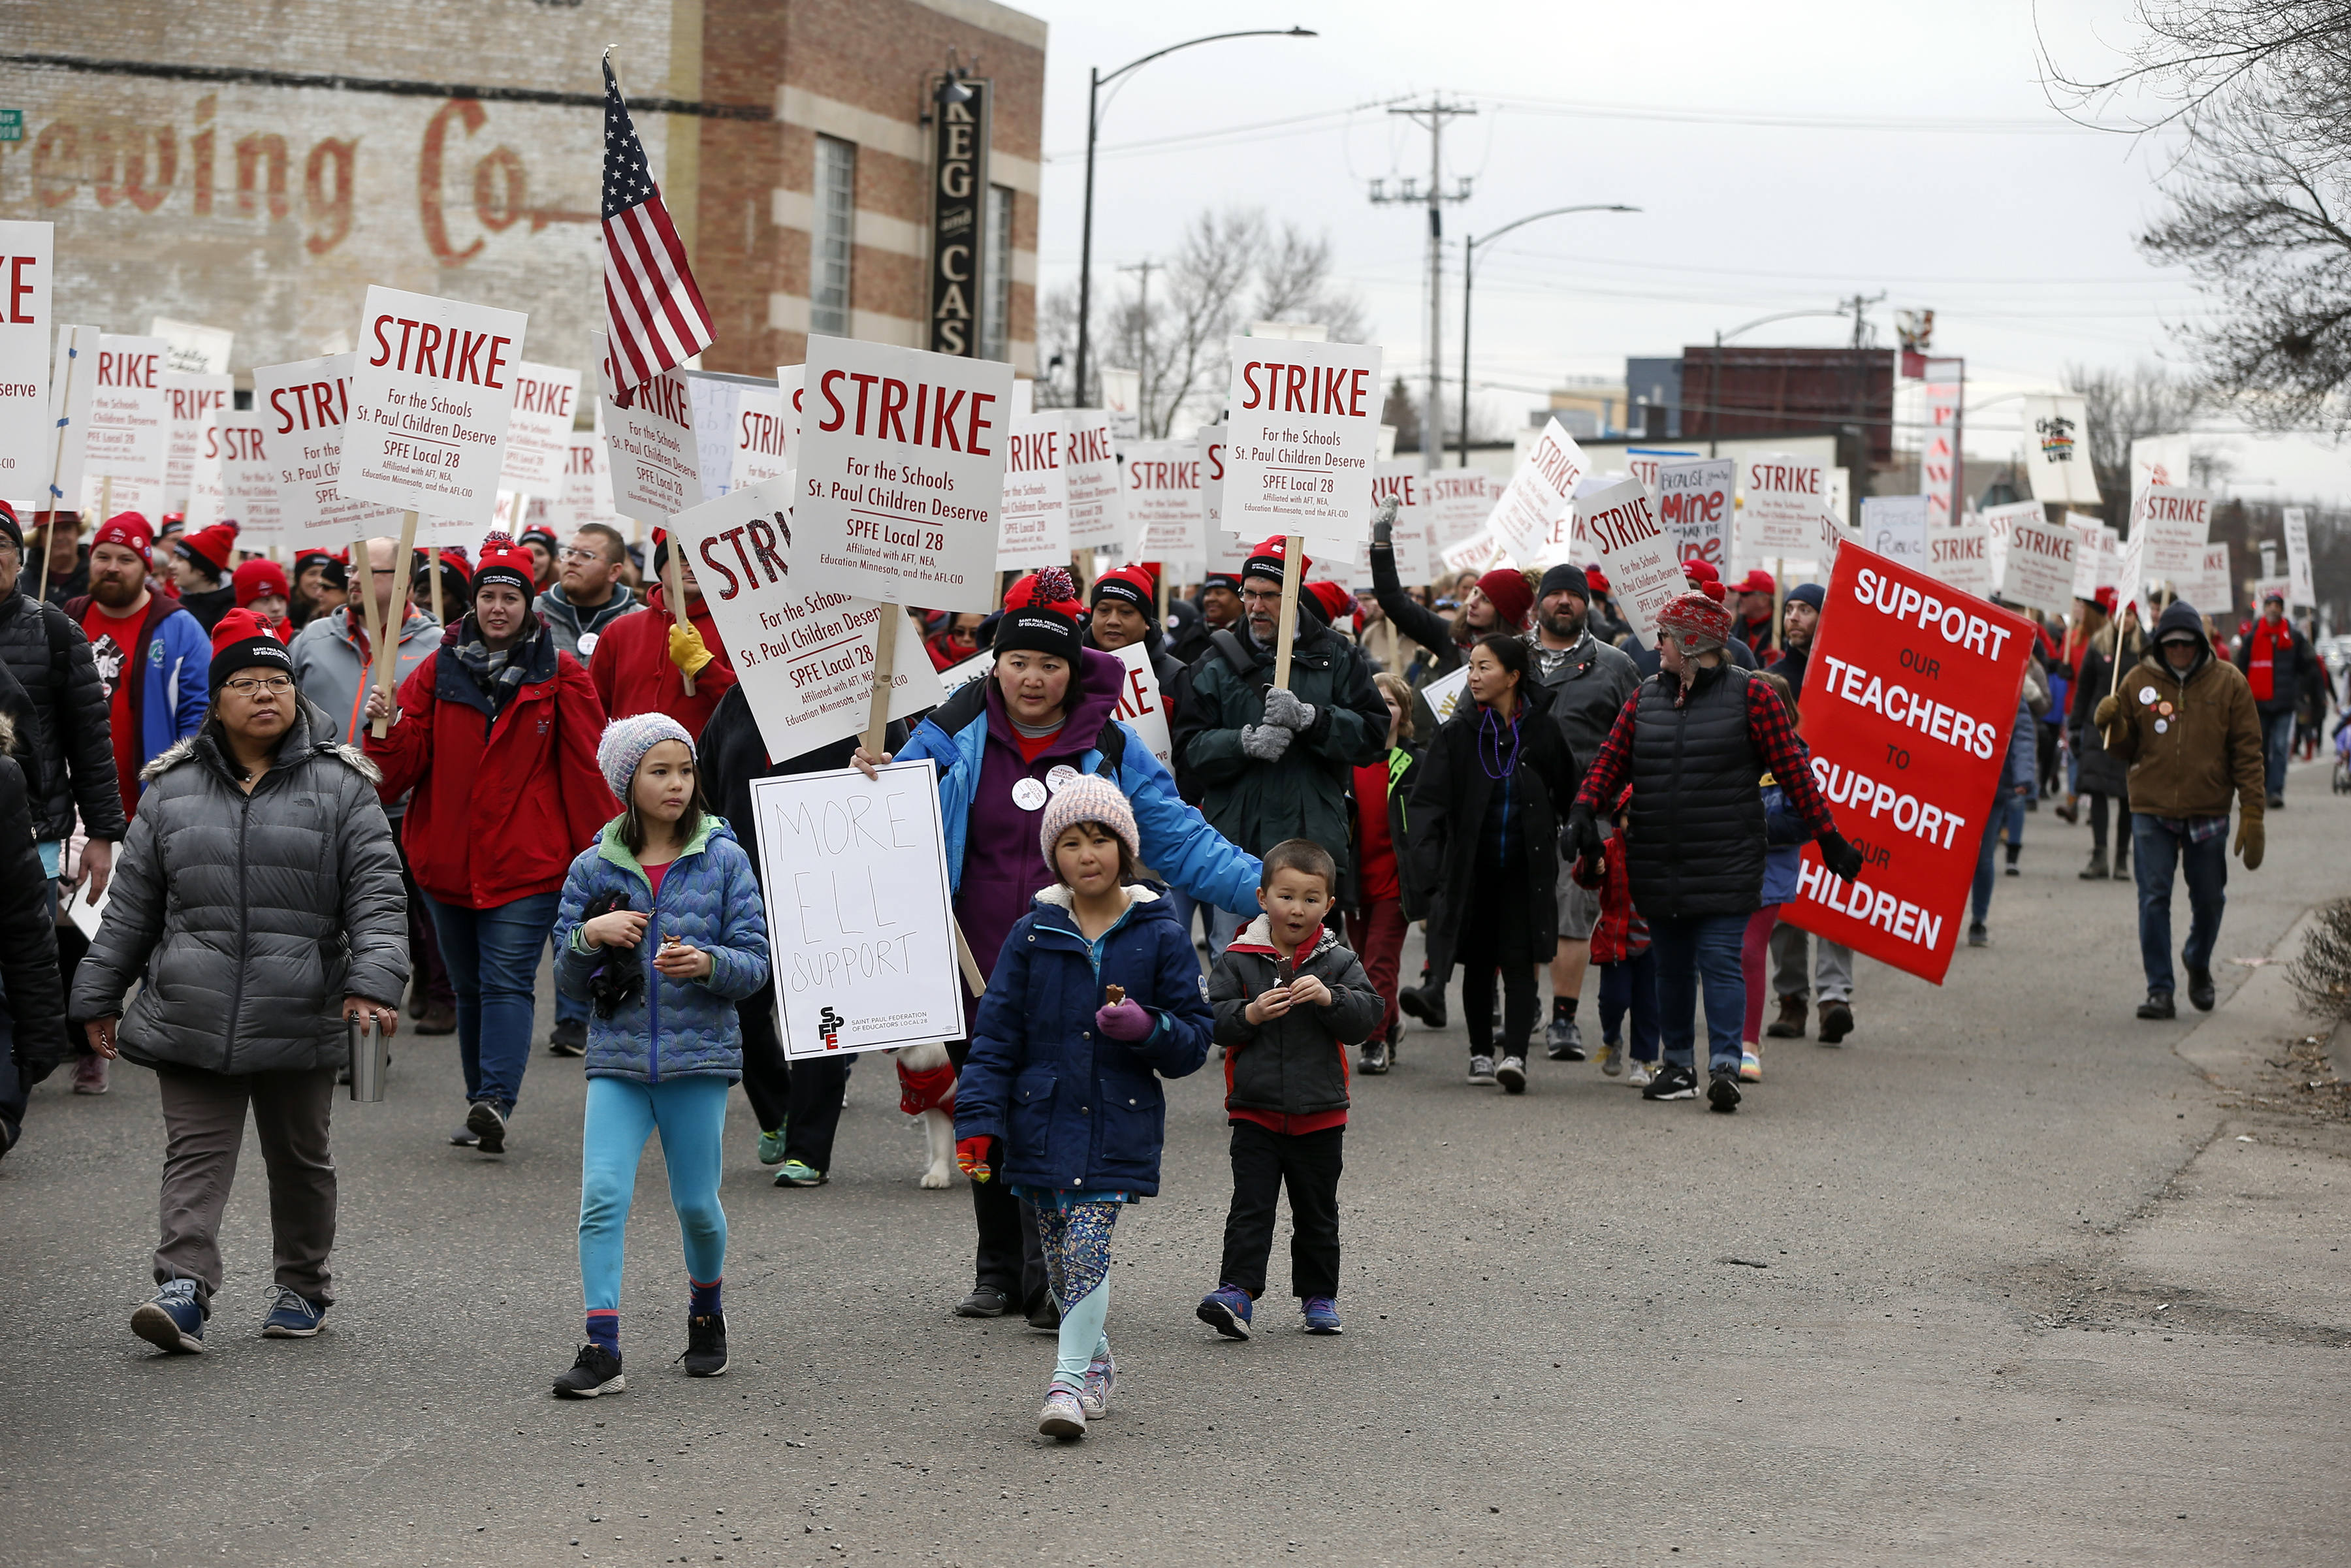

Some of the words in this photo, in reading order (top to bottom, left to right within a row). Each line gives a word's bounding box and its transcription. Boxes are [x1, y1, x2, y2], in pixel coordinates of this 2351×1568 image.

[29, 94, 359, 255] ewing
[935, 245, 971, 355] CAS
[368, 315, 511, 389] STRIKE
[270, 377, 353, 434] STRI
[388, 388, 407, 405] For
[409, 391, 427, 409] the
[431, 396, 472, 418] Schools
[1242, 362, 1369, 417] STRIKE
[357, 406, 370, 422] St.
[374, 409, 400, 426] Paul
[403, 414, 449, 437] Children
[452, 424, 497, 445] Deserve
[819, 370, 995, 456] STRIKE
[304, 447, 320, 460] For
[323, 442, 340, 456] the
[629, 421, 641, 436] For
[643, 425, 655, 441] the
[656, 430, 680, 453] Schools
[1004, 432, 1058, 472] RIKE
[1263, 427, 1279, 441] For
[1283, 427, 1298, 443] the
[1302, 430, 1340, 446] Schools
[383, 440, 411, 458] SPFE
[413, 445, 442, 465] Local
[445, 452, 460, 468] 28
[612, 436, 623, 449] St.
[625, 438, 642, 456] Paul
[644, 445, 671, 465] Children
[673, 457, 697, 480] Deserve
[1235, 447, 1247, 460] St.
[1251, 447, 1275, 462] Paul
[1278, 448, 1320, 466] Children
[1324, 453, 1366, 468] Deserve
[1531, 436, 1580, 499] STRIKE
[282, 470, 296, 483] St.
[298, 464, 321, 481] Paul
[361, 468, 391, 481] Education
[392, 474, 423, 490] Minnesota,
[425, 482, 438, 490] and
[439, 483, 449, 493] the
[449, 486, 473, 496] AFL-CIO
[382, 460, 410, 473] Affiliated
[411, 467, 424, 475] with
[424, 469, 437, 480] AFT,
[439, 472, 453, 483] NEA,
[637, 466, 654, 485] SPFE
[656, 473, 673, 491] Local
[674, 482, 683, 497] 28
[847, 456, 870, 476] For
[874, 460, 896, 481] the
[902, 466, 953, 490] Schools
[1131, 461, 1200, 489] STRIKE
[1263, 474, 1287, 490] SPFE
[1290, 477, 1317, 492] Local
[1320, 479, 1334, 493] 28
[1435, 475, 1486, 500] STRIKE
[1751, 464, 1820, 494] STRIKE
[808, 479, 825, 497] St.
[831, 481, 863, 502] Paul
[868, 487, 926, 513] Children
[931, 498, 987, 522] Deserve
[1244, 503, 1271, 512] Education
[1273, 505, 1302, 517] Minnesota,
[1317, 509, 1326, 517] the
[1327, 509, 1349, 518] AFL-CIO
[1263, 492, 1288, 503] Affiliated
[1290, 496, 1302, 504] with
[1303, 497, 1314, 506] AFT,
[1316, 498, 1328, 507] NEA,
[2147, 496, 2207, 524] STRIKE
[846, 519, 880, 540] SPFE
[884, 525, 920, 547] Local
[925, 532, 943, 551] 28
[1591, 496, 1661, 554] STRIKE
[699, 506, 793, 600] STRI
[846, 542, 880, 557] Affiliated
[883, 550, 899, 560] with
[901, 552, 916, 565] AFT,
[920, 555, 936, 568] NEA,
[1931, 536, 1986, 564] STRIKE
[2014, 526, 2074, 562] STRIKE
[820, 553, 857, 568] Education
[859, 559, 900, 577] Minnesota,
[903, 568, 918, 578] and
[920, 569, 932, 580] the
[934, 572, 963, 584] AFL-CIO
[1620, 564, 1631, 575] For
[1630, 559, 1640, 571] the
[1639, 551, 1660, 568] Schools
[1616, 585, 1625, 597] St.
[1623, 577, 1637, 594] Paul
[1635, 573, 1659, 588] Children
[1657, 566, 1679, 581] Deserve
[760, 613, 781, 630] For
[782, 602, 805, 622] the
[1638, 598, 1653, 613] SPFE
[1650, 592, 1667, 609] Local
[1855, 568, 2011, 662] SUPPORT
[741, 650, 761, 668] St.
[760, 634, 791, 661] Paul
[792, 622, 844, 648] Children
[789, 663, 822, 688] SPFE
[820, 650, 856, 677] Local
[856, 645, 875, 665] 28
[1899, 648, 1941, 680] OUR
[785, 709, 818, 726] Education
[819, 697, 856, 714] Minnesota,
[856, 688, 869, 701] and
[801, 685, 831, 704] Affiliated
[831, 680, 847, 694] with
[1825, 655, 1996, 760] TEACHERS
[1886, 744, 1911, 771] TO
[1810, 756, 1965, 850] SUPPORT
[776, 792, 916, 861] MORE
[1851, 838, 1891, 870] OUR
[794, 865, 897, 944] ELL
[792, 932, 918, 992] SUPPORT
[862, 1022, 899, 1031] EDUCATORS
[888, 1012, 927, 1022] FEDERATION
